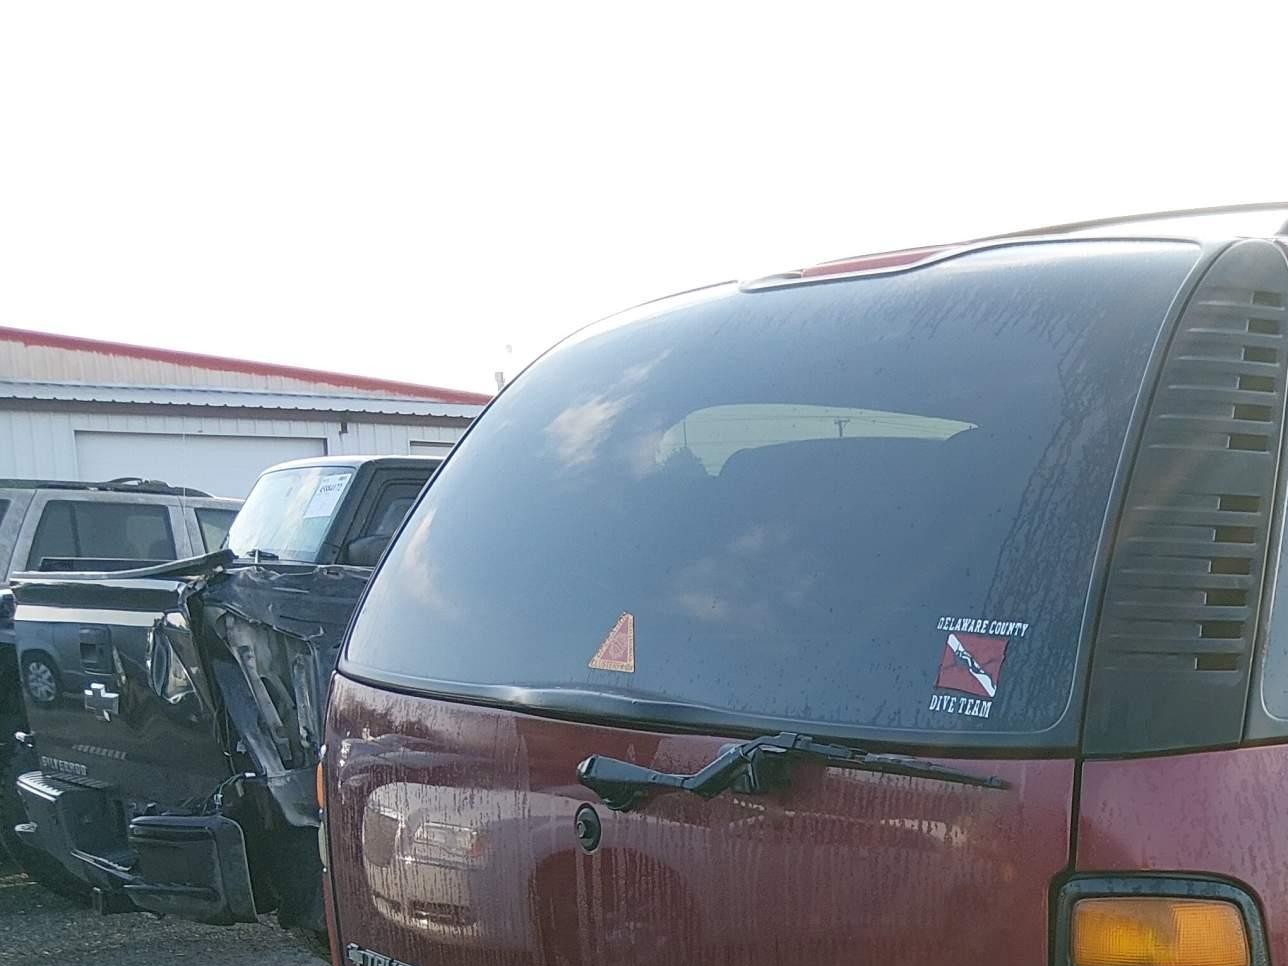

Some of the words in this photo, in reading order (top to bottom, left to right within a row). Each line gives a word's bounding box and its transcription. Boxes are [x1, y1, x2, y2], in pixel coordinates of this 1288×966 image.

[937, 617, 988, 633] DELAWARE
[989, 620, 1029, 637] COUNTY
[929, 695, 957, 712] DIVE
[958, 699, 992, 718] TEAM
